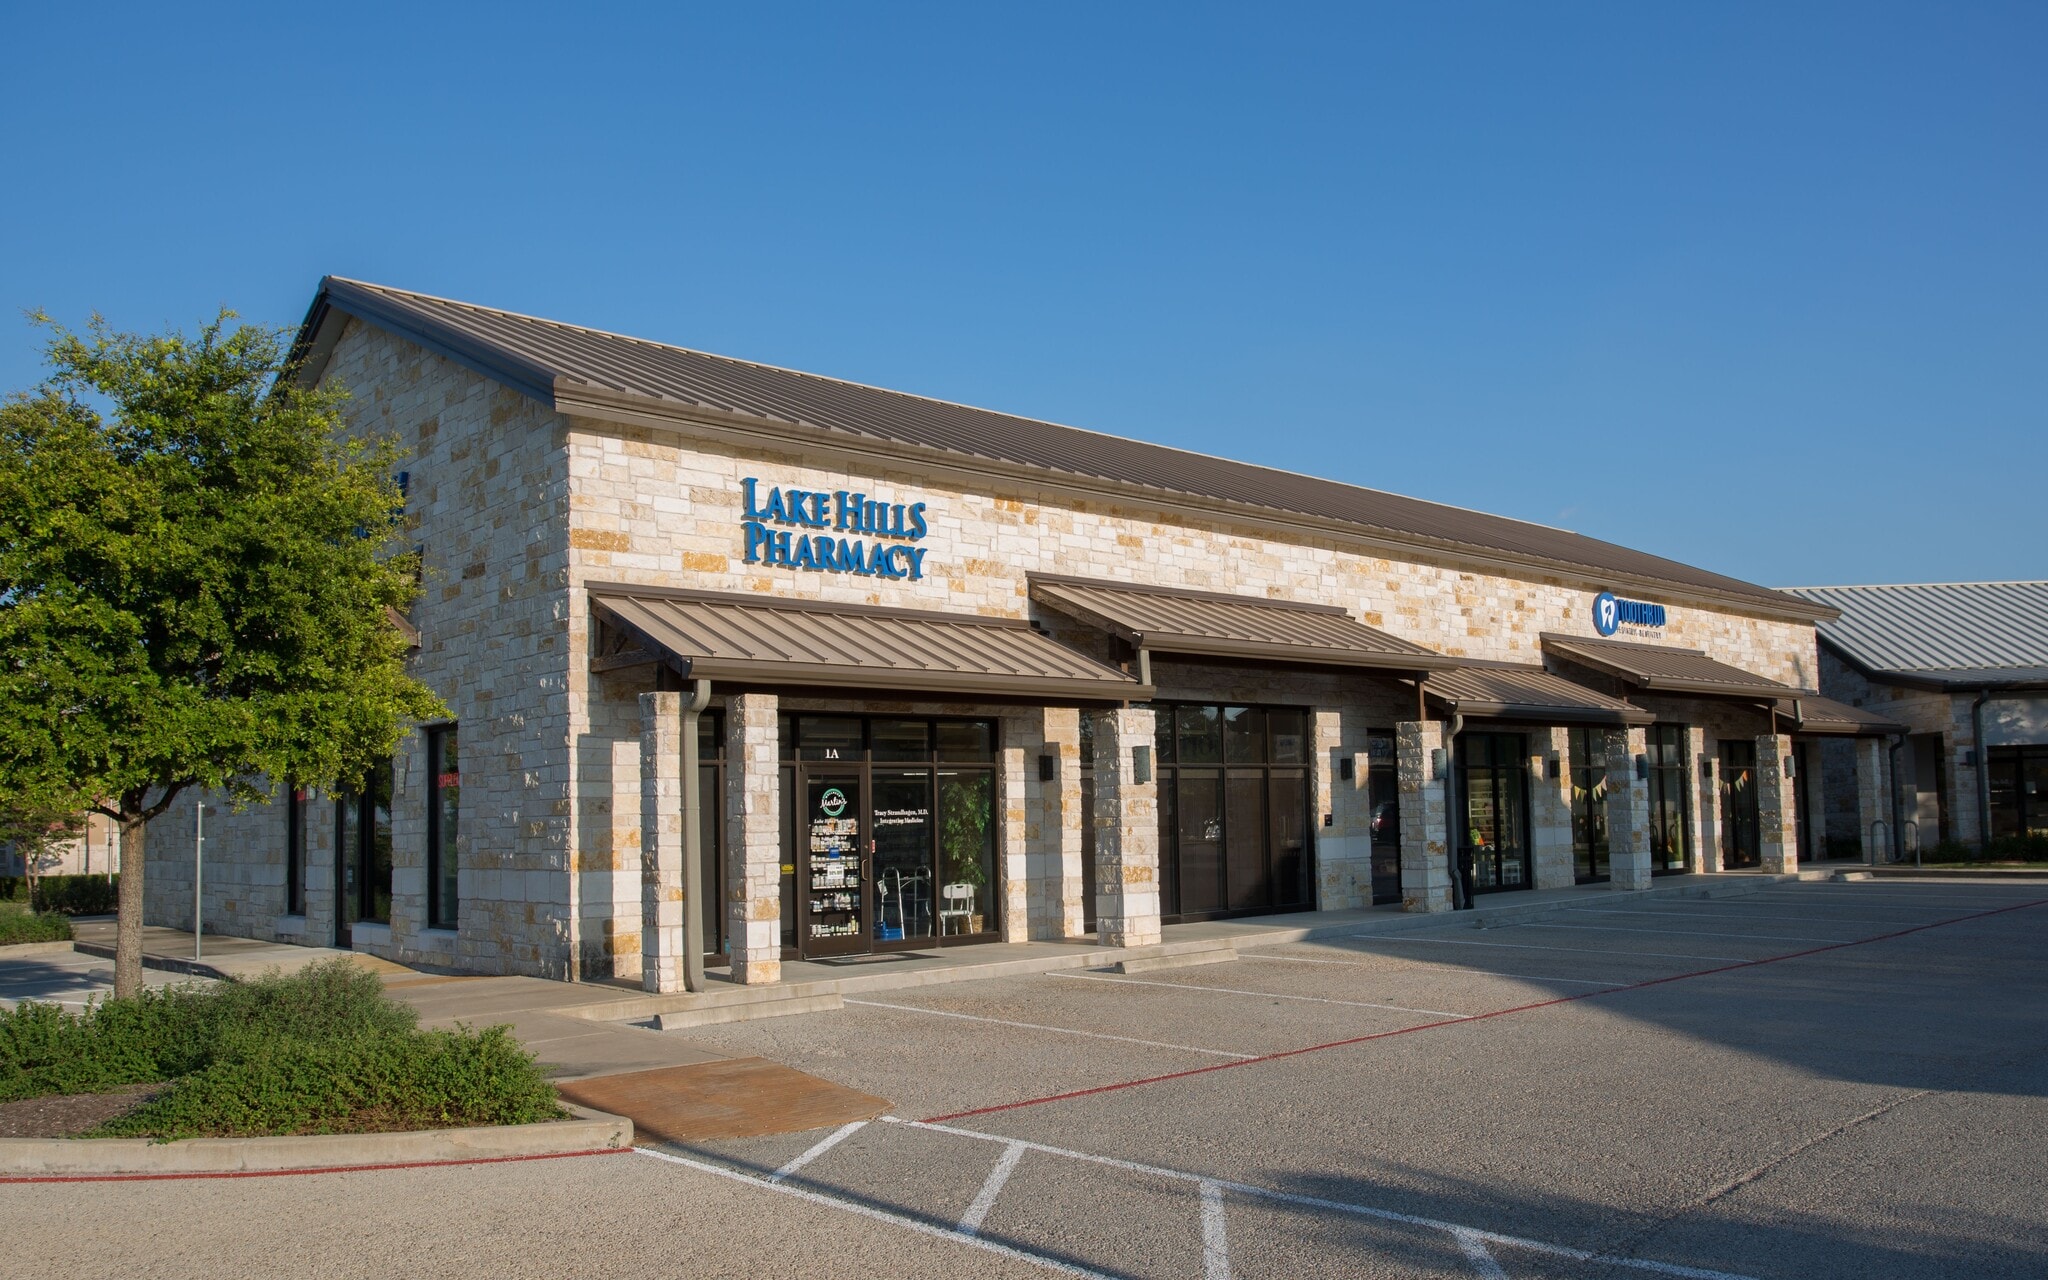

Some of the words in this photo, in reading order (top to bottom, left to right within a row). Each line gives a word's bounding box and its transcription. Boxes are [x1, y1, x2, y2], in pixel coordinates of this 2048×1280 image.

[741, 477, 831, 528] LAKE
[833, 491, 928, 541] HILLS
[741, 522, 928, 581] PHARMACY
[1617, 599, 1666, 627] TOOTHBUD
[824, 748, 840, 759] 1A
[874, 809, 887, 817] Tracy
